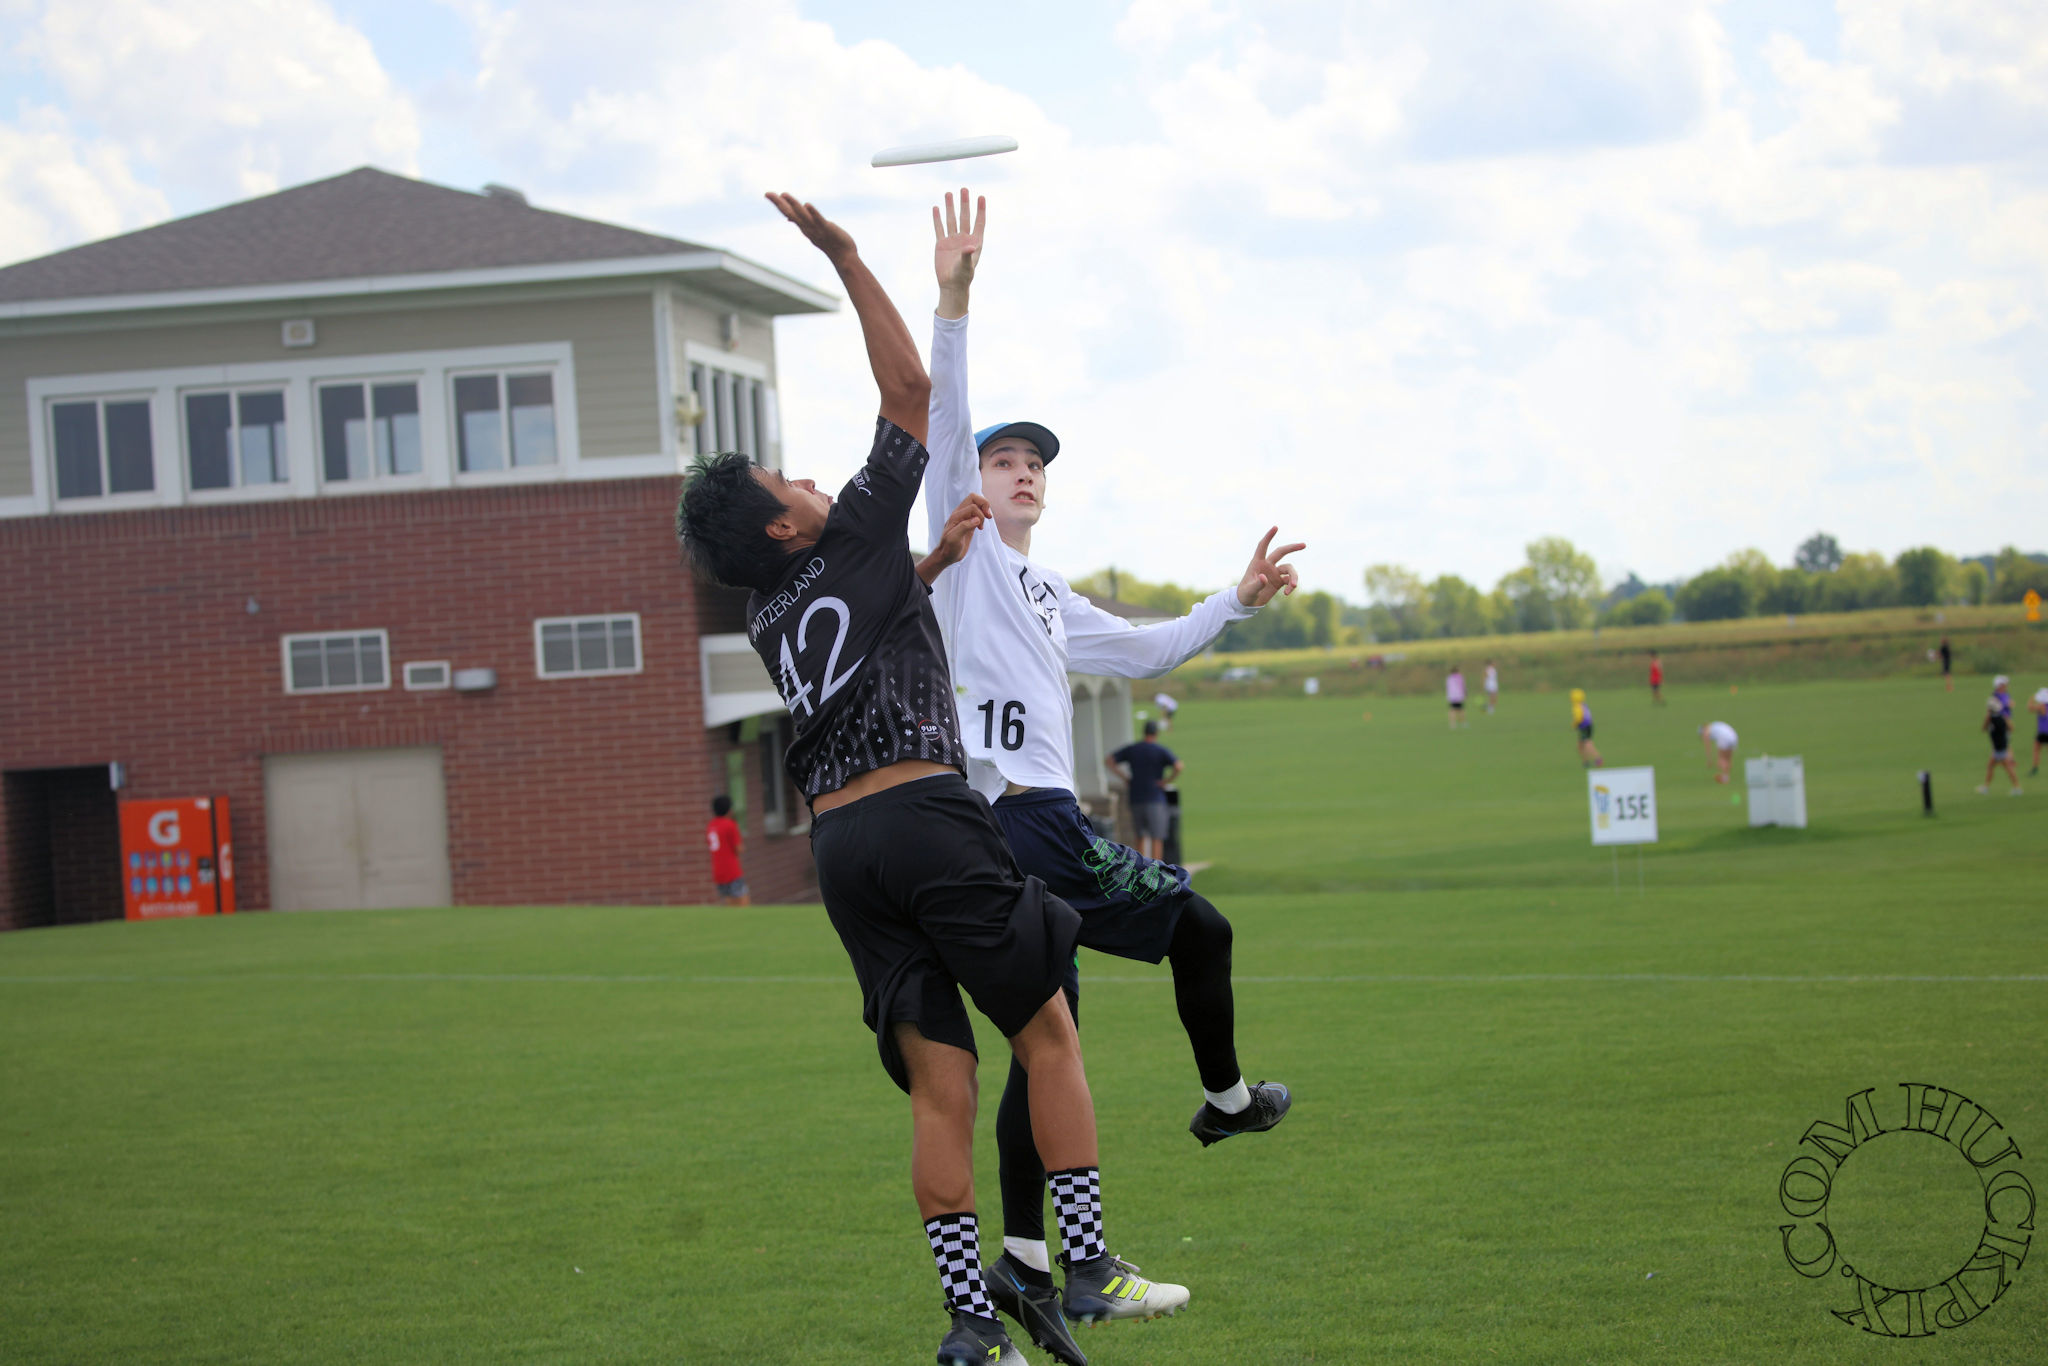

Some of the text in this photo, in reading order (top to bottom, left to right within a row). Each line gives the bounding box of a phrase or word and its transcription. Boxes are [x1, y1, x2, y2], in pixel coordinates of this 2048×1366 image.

[778, 596, 867, 717] 42
[977, 699, 1026, 751] 16
[148, 809, 181, 846] G
[1616, 793, 1650, 820] 15E
